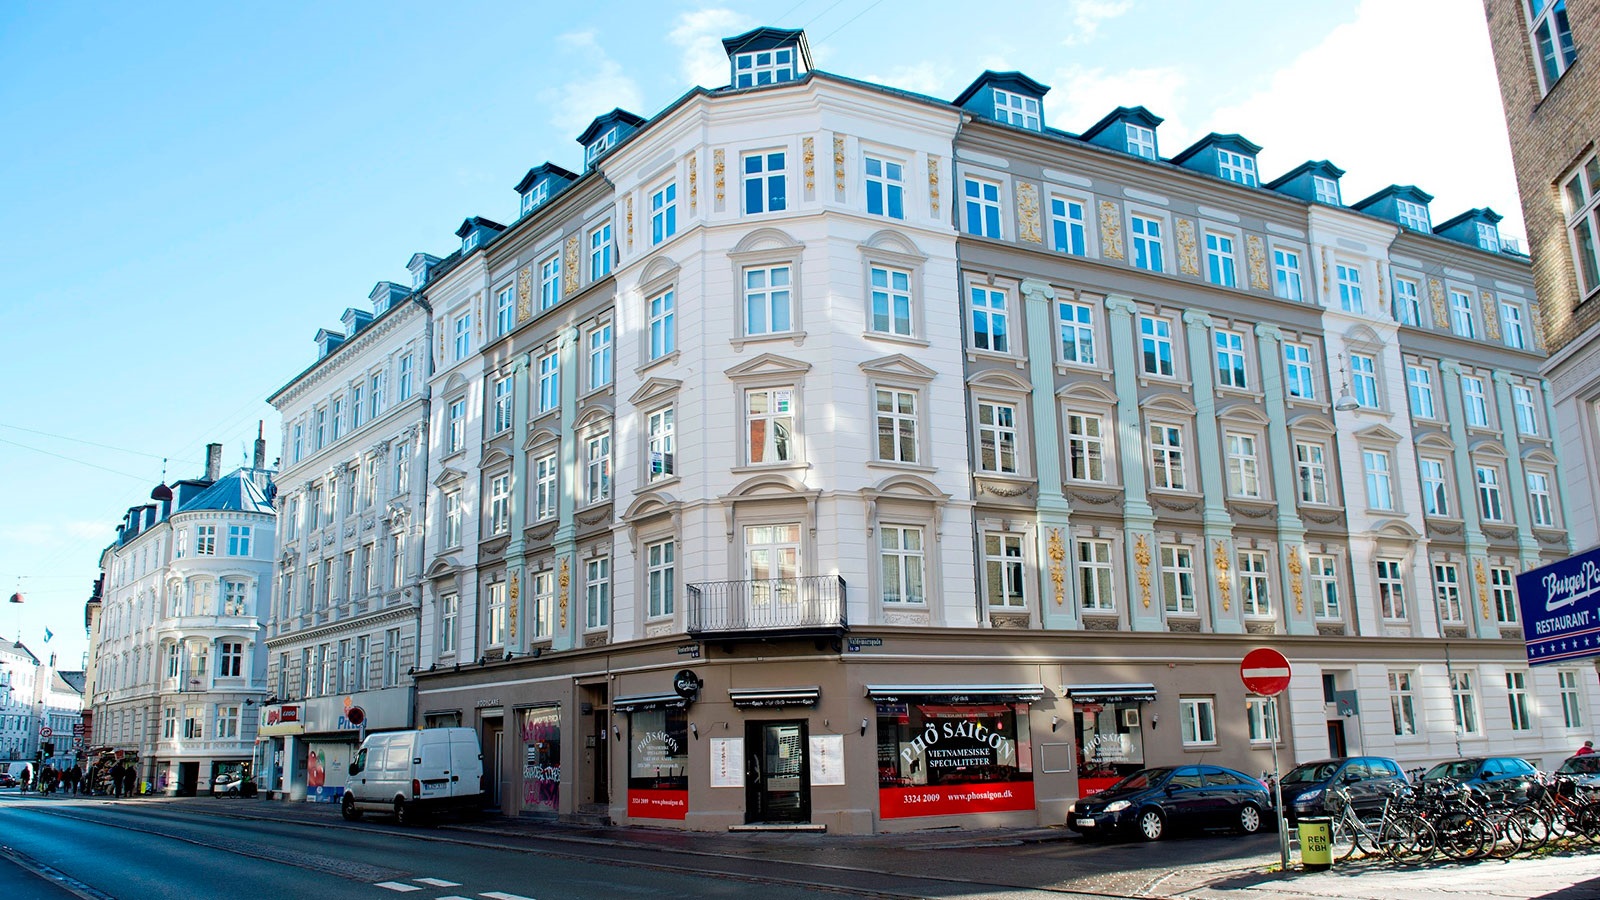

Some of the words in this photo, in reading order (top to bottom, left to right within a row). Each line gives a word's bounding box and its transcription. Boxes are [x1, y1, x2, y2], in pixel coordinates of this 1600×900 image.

[1542, 569, 1586, 606] Burger
[1536, 610, 1590, 635] RESTAURANT
[927, 747, 991, 758] VIETNAMESISKE
[929, 757, 991, 768] SPECIALITETER
[903, 794, 921, 803] 3324
[922, 793, 940, 802] 2009
[947, 789, 1013, 802] www.phosaigon.dk
[1307, 835, 1326, 843] REN
[1308, 844, 1327, 852] KBH
